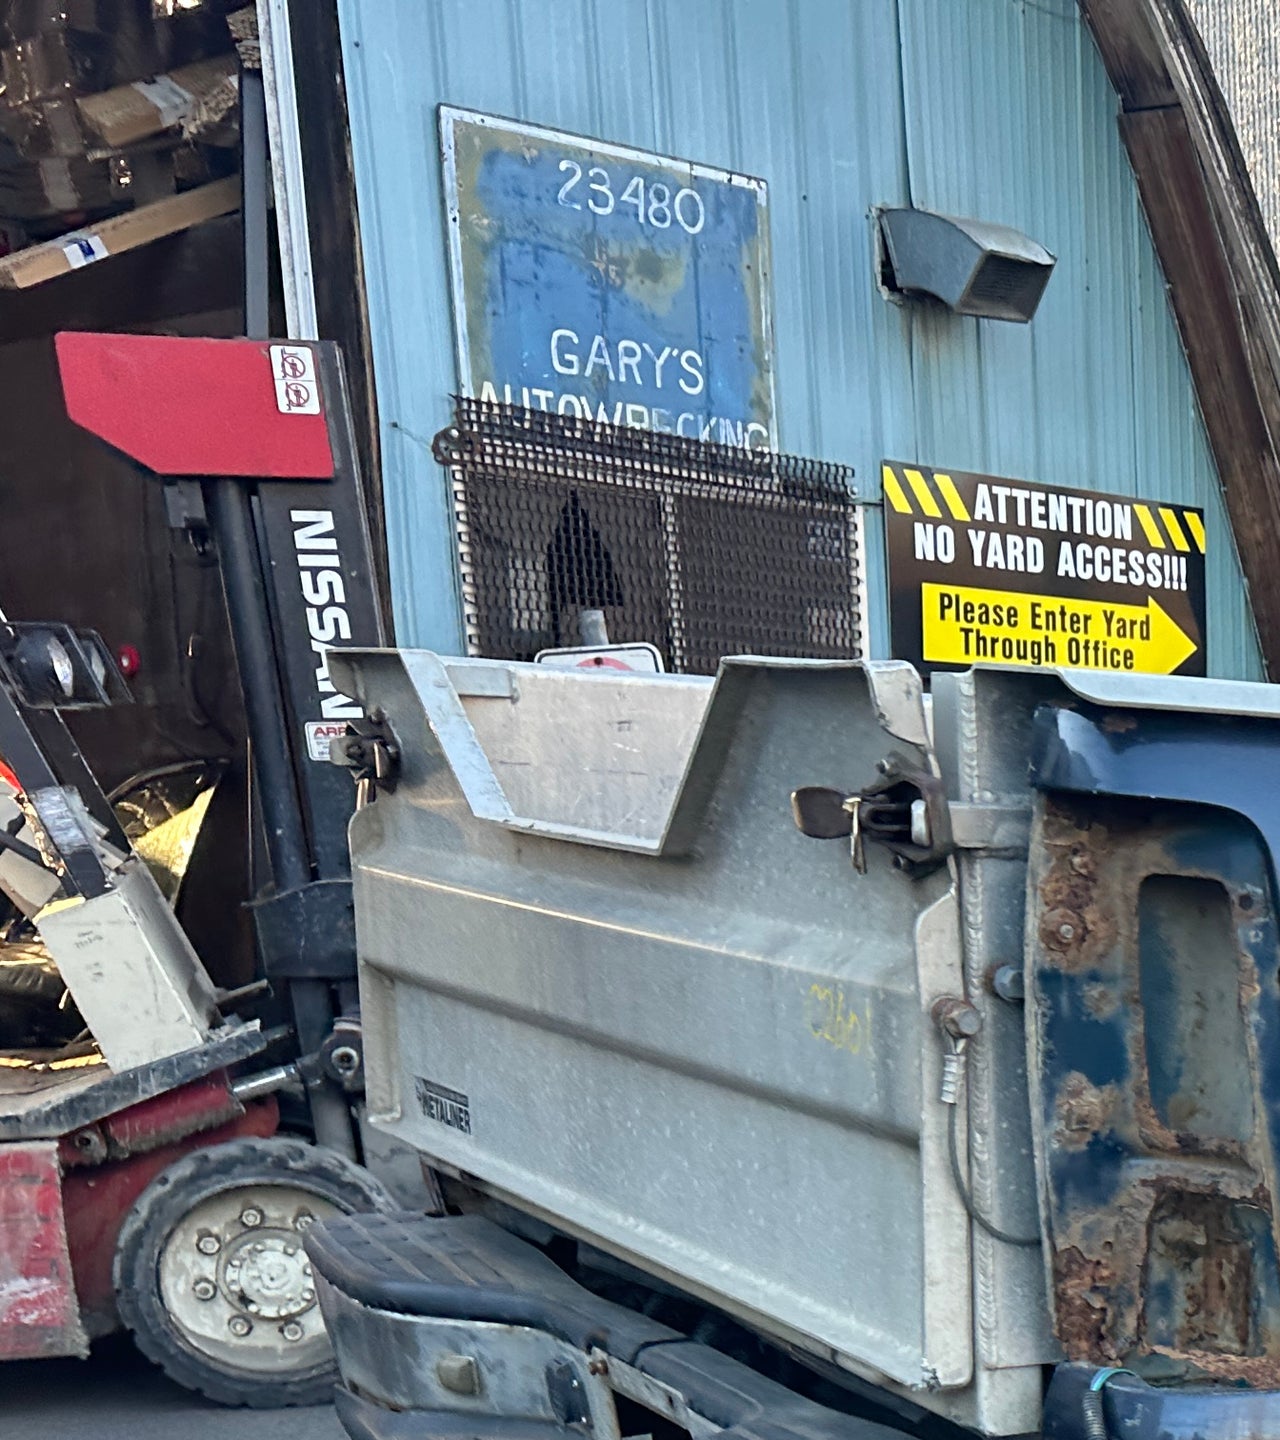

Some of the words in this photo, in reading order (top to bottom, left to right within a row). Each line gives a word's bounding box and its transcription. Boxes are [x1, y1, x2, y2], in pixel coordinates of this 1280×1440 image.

[557, 159, 706, 234] 23480
[551, 328, 704, 396] GARY'S
[974, 482, 1133, 541] ATTENTION
[913, 521, 956, 564] NO
[967, 530, 1045, 574] YARD
[1057, 541, 1188, 591] ACCESS!!!
[939, 591, 1019, 629] Please
[1031, 602, 1092, 636] Enter
[1102, 608, 1151, 641] Yard
[959, 626, 1056, 665] Through
[1067, 638, 1135, 670] Office
